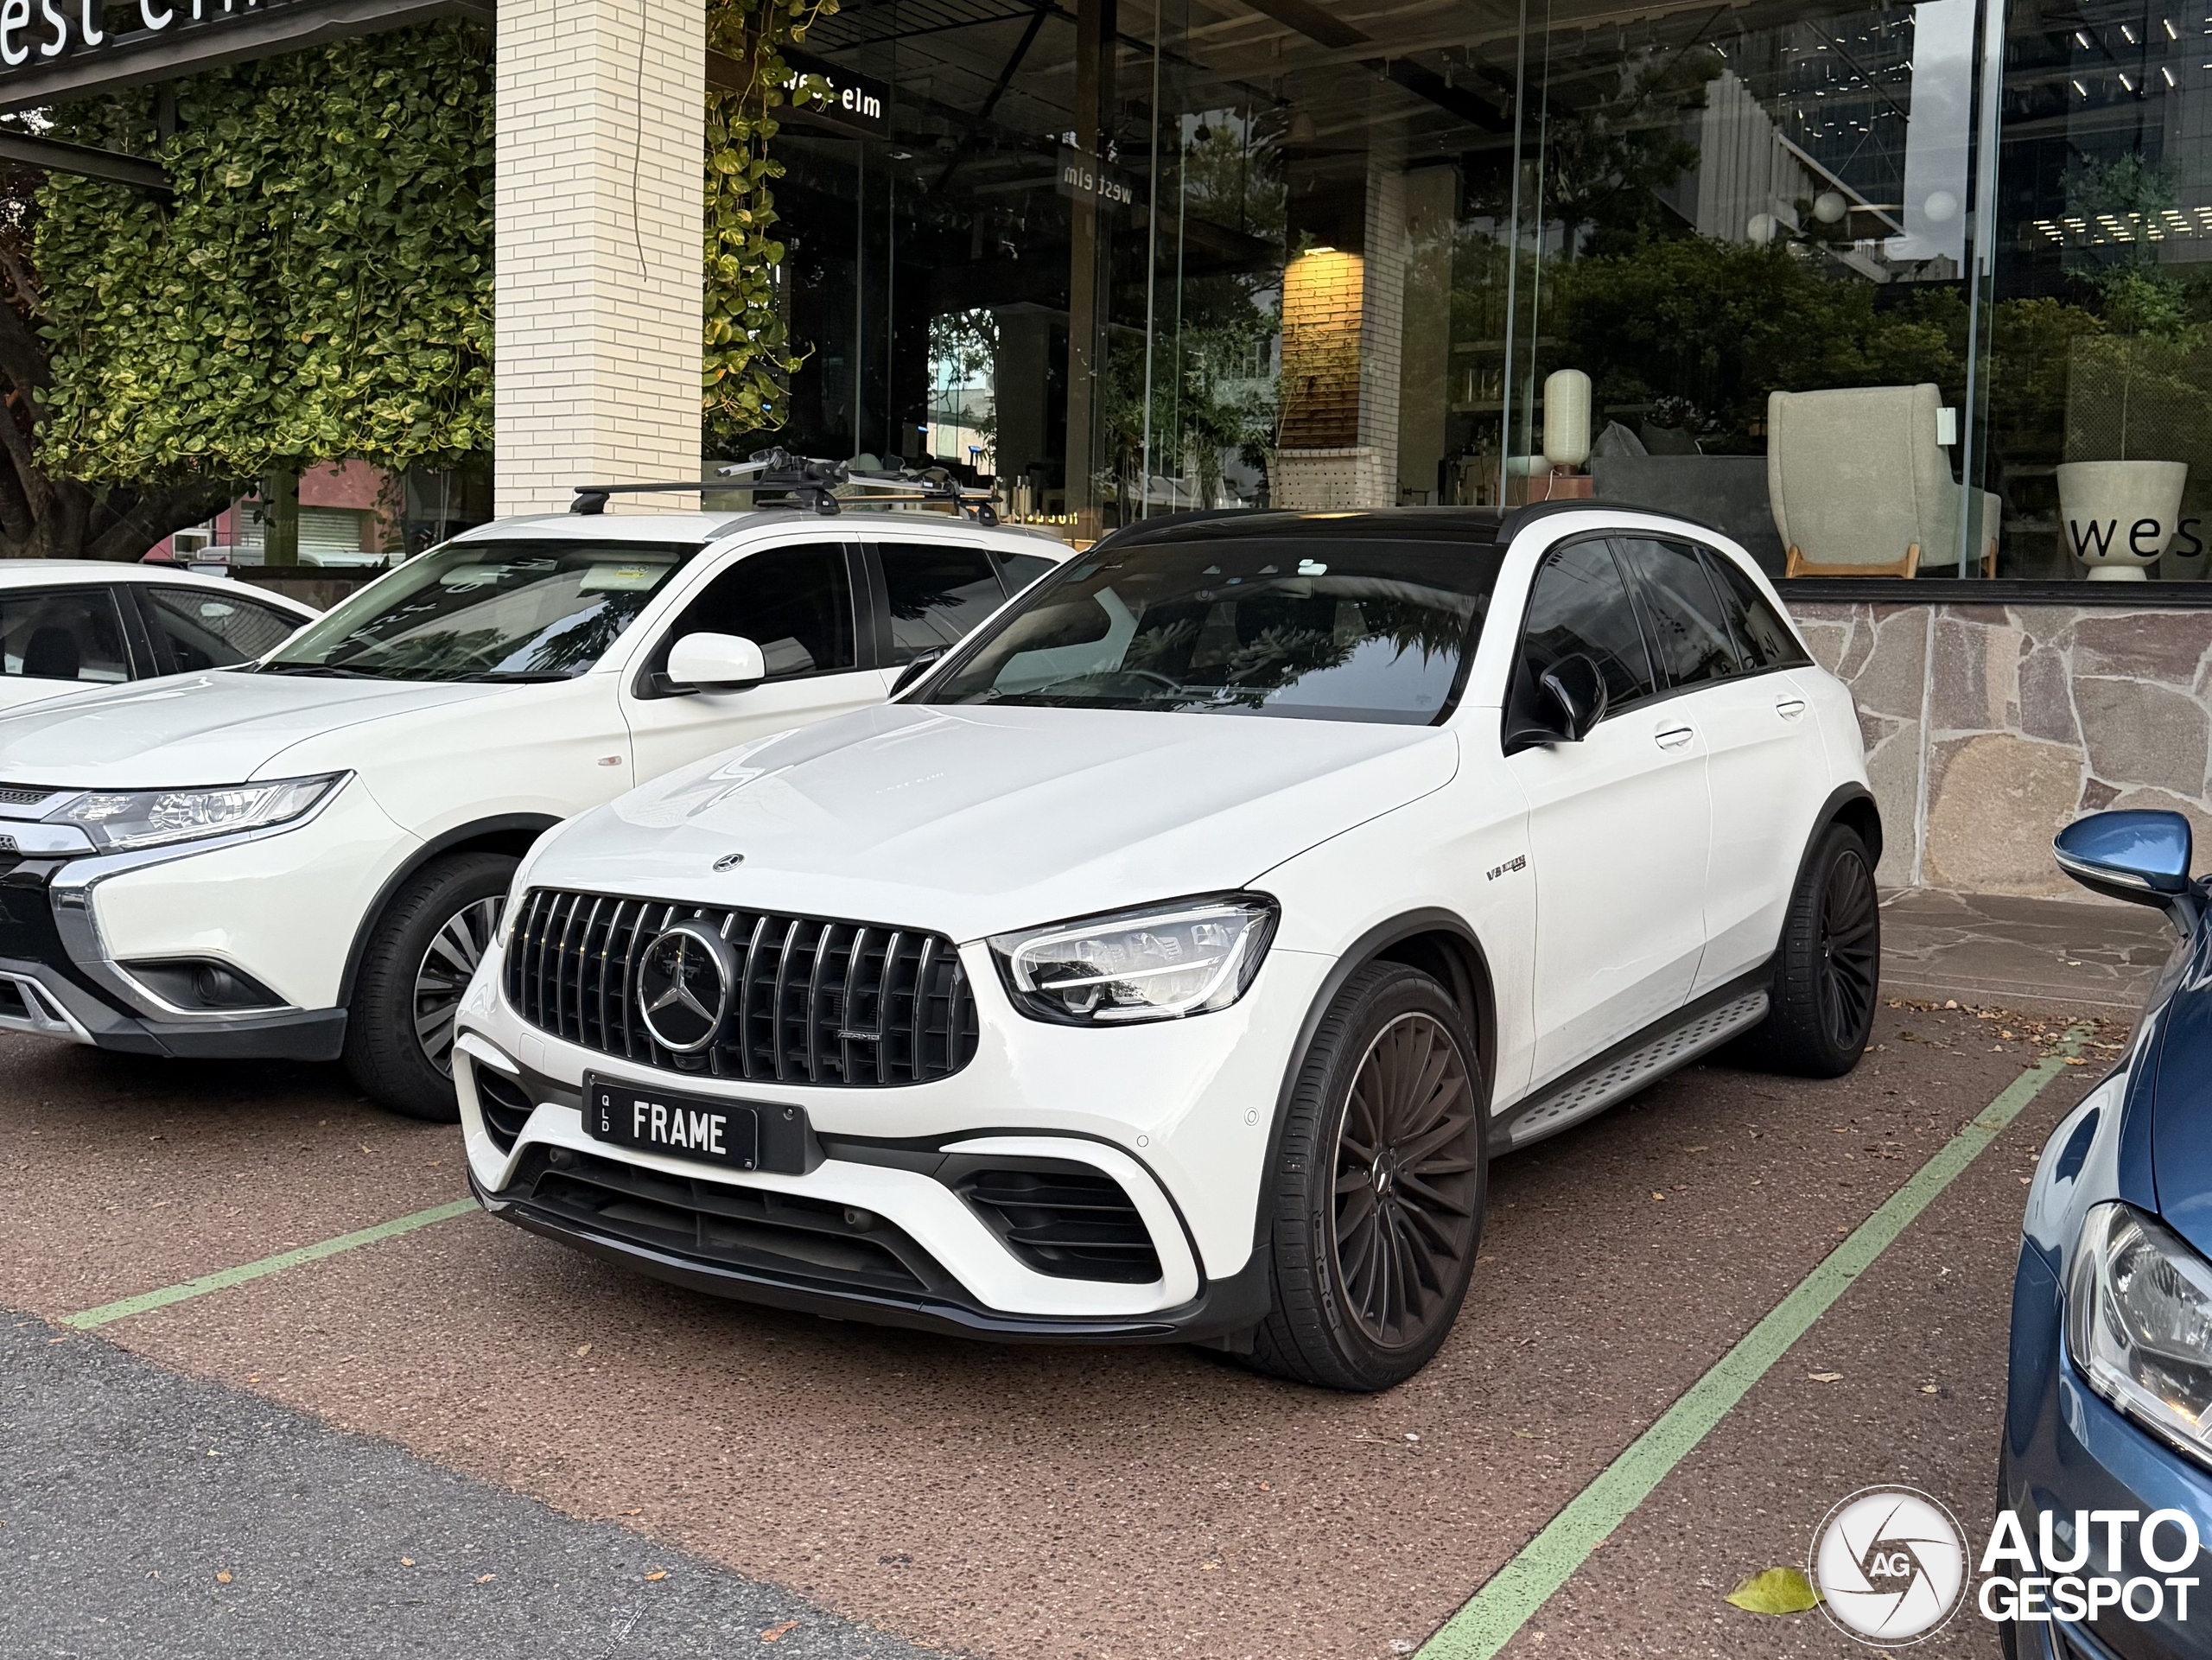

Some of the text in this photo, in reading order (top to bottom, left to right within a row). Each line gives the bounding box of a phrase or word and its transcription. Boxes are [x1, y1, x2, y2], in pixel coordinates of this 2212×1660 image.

[842, 87, 880, 118] elm
[2070, 518, 2202, 557] wes
[601, 1095, 610, 1132] QLD
[633, 1100, 727, 1155] FRAME
